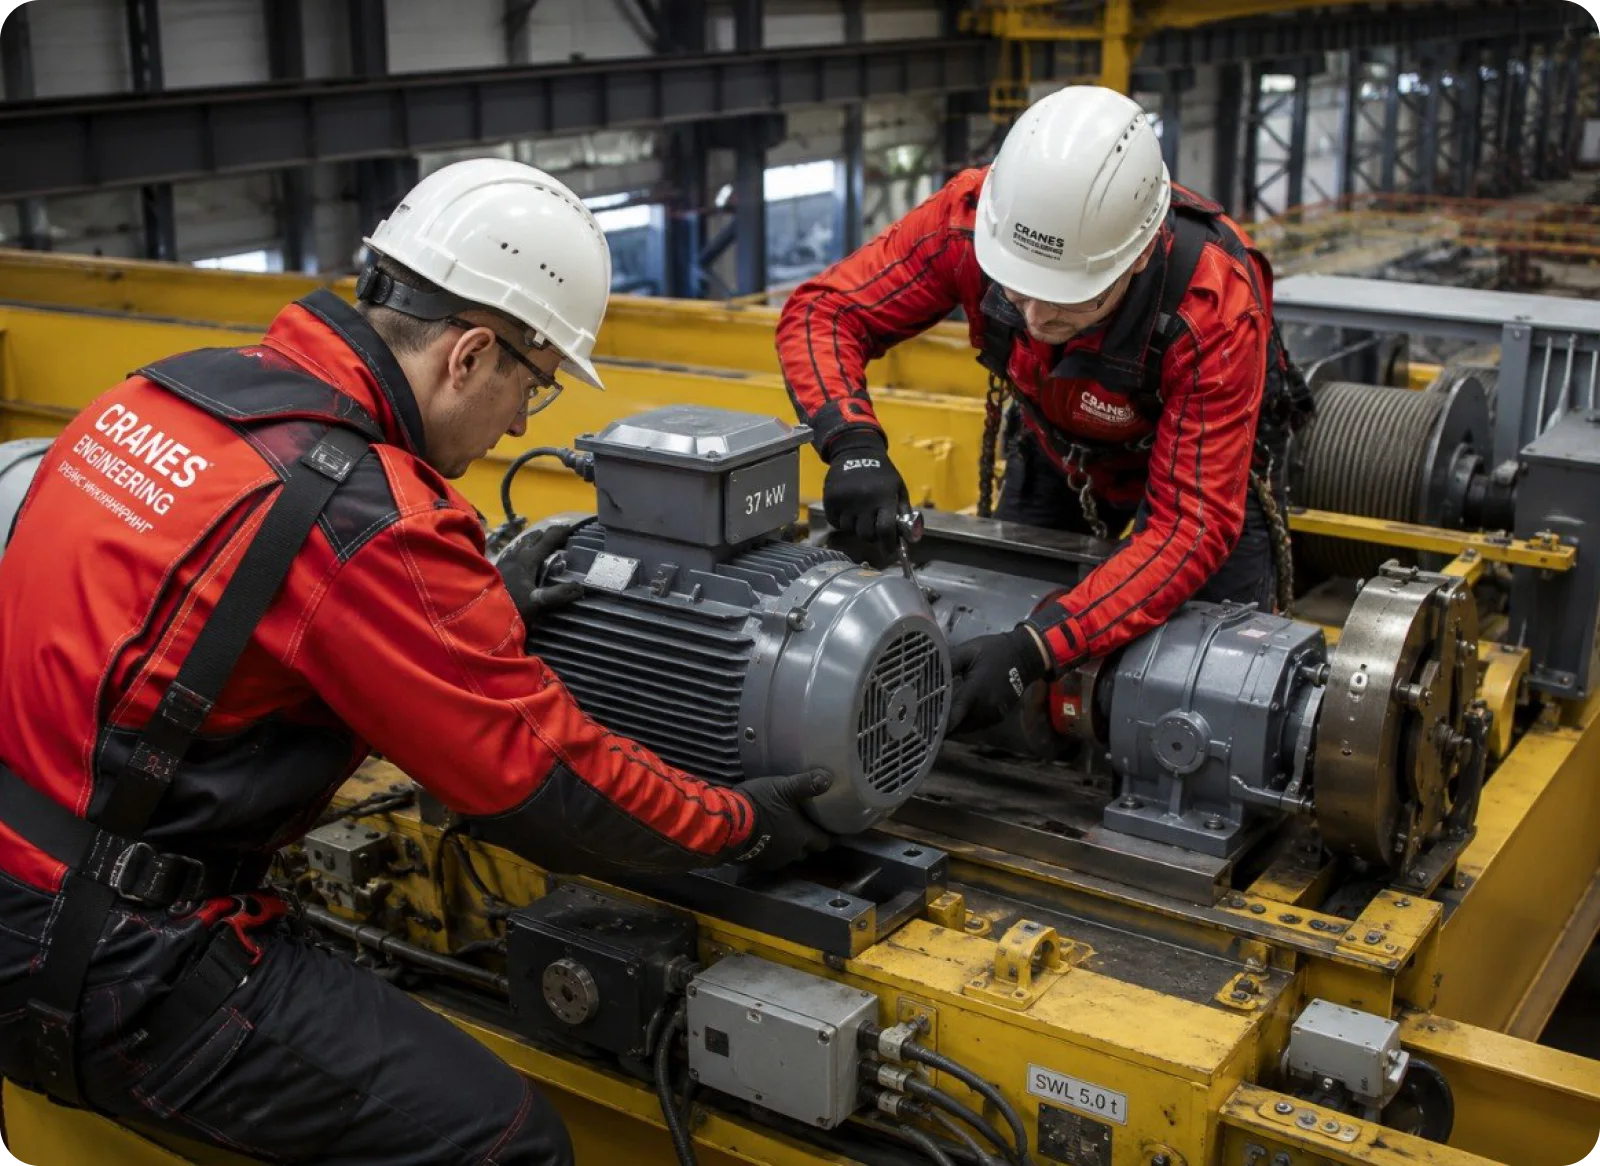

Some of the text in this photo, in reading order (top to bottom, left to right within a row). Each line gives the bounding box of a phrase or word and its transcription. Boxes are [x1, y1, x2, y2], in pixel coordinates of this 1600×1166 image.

[1015, 222, 1065, 248] CRANES
[95, 403, 208, 488] CRANES
[72, 433, 175, 515] ENGINEERING
[745, 483, 786, 515] 37 kW
[1036, 1074, 1117, 1115] SWL 5.0 t
